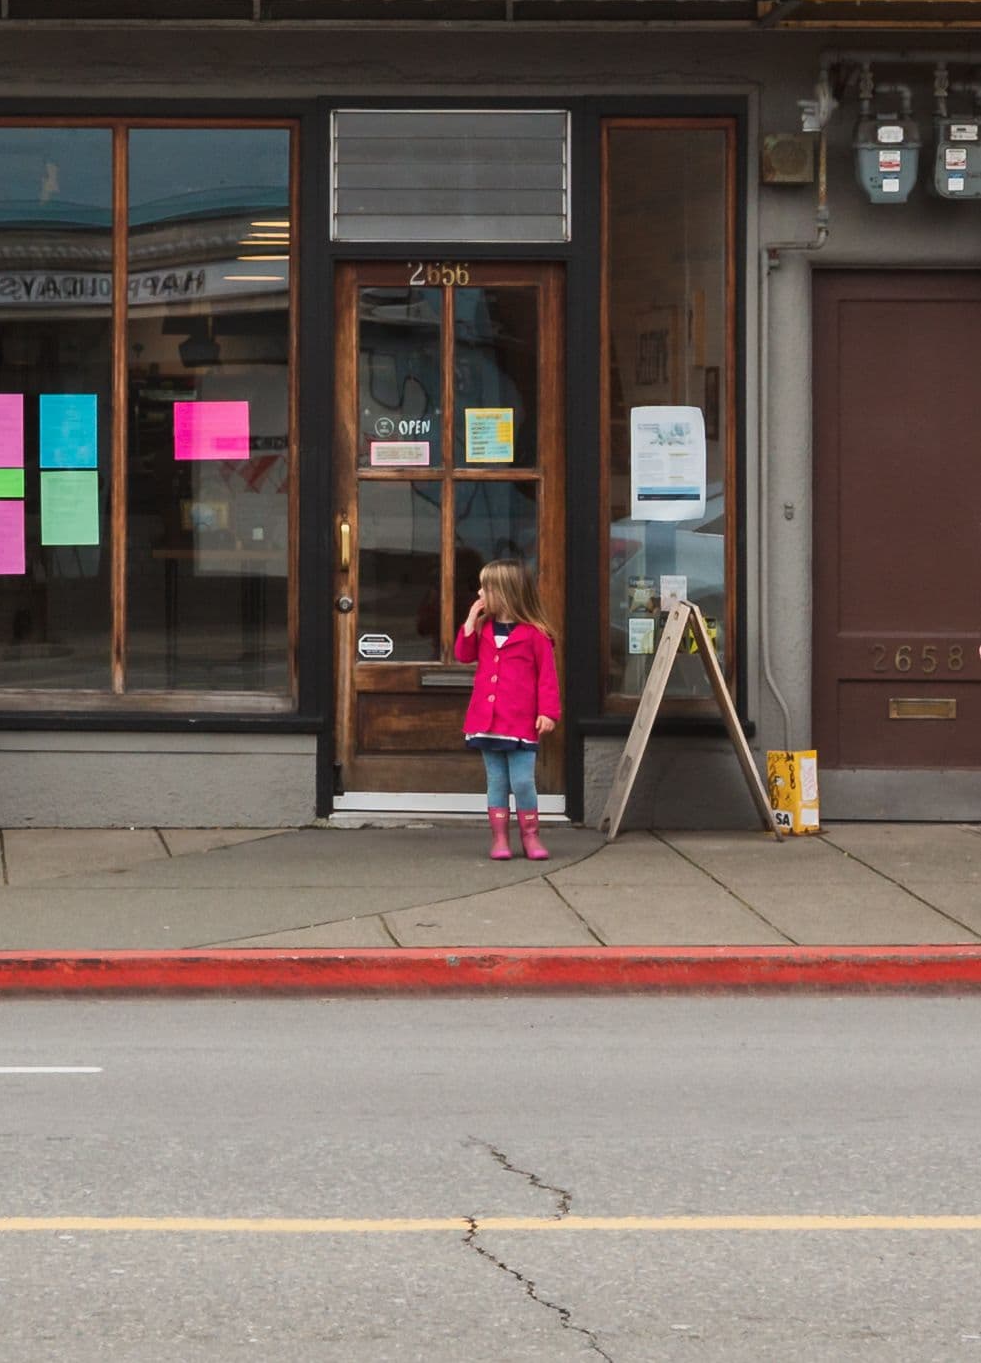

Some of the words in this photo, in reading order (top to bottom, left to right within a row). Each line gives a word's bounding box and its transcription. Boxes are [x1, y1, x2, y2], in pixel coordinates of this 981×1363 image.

[409, 262, 470, 287] 2656
[398, 420, 431, 436] OPEN
[874, 644, 963, 673] 2658
